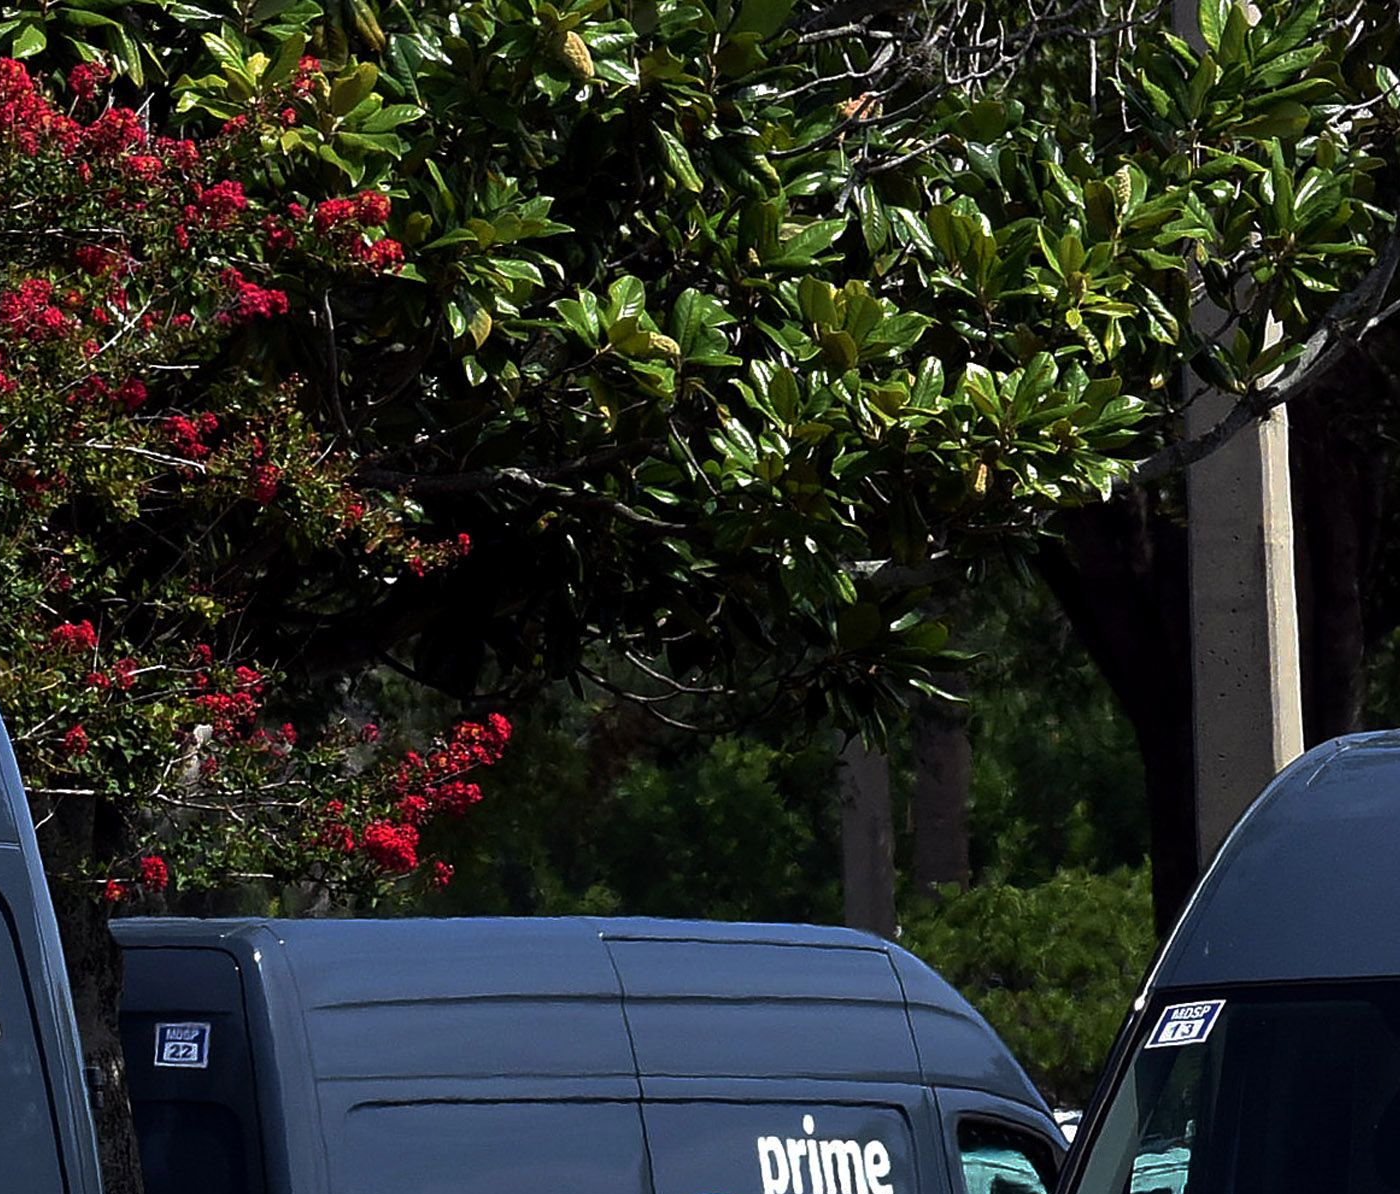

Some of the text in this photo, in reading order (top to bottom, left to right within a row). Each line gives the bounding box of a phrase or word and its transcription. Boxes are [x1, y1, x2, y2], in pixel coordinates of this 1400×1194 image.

[1170, 1005, 1212, 1020] MDSP
[1170, 1022, 1196, 1039] 13
[168, 1043, 194, 1059] 22
